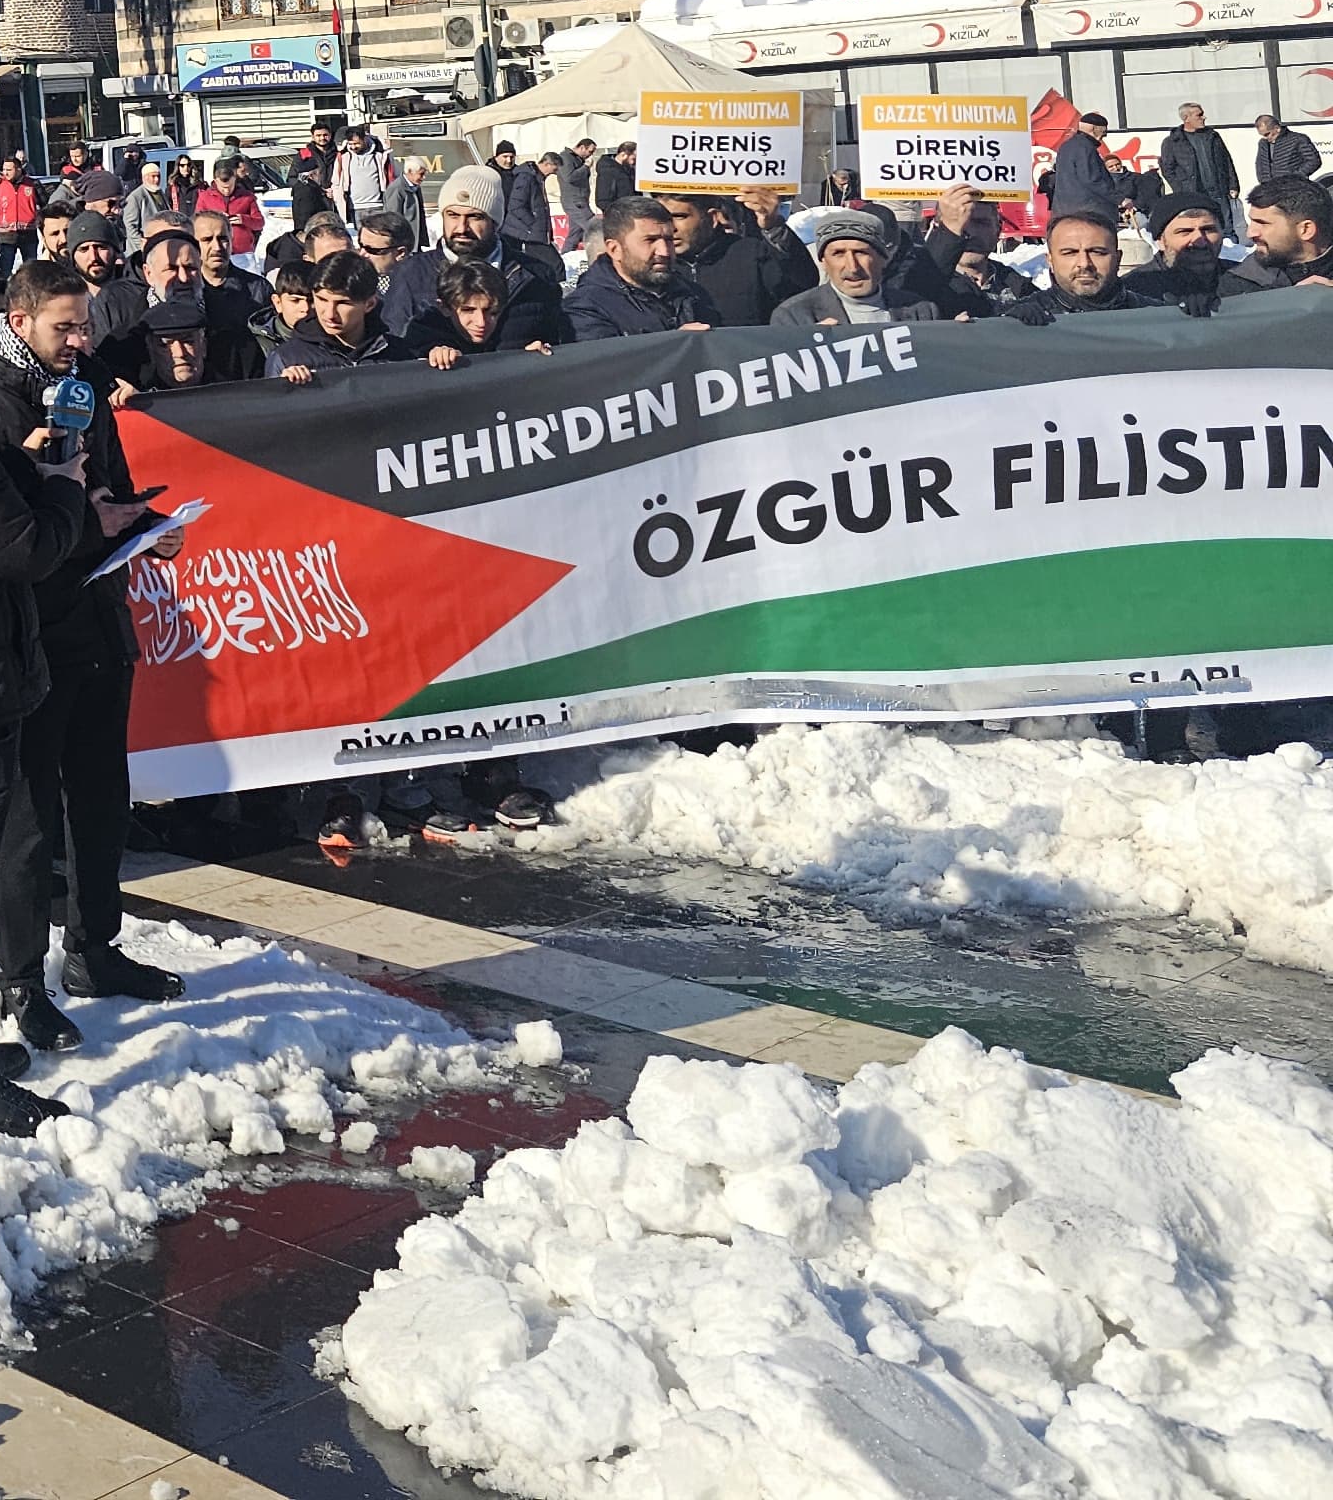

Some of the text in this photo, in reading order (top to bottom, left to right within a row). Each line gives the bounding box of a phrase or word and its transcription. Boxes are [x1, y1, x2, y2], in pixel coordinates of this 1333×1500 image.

[1095, 16, 1141, 29] KIZILAY
[1208, 7, 1255, 21] KIZILAY
[852, 37, 891, 50] KIZILAY
[949, 28, 990, 41] KIZILAY
[760, 46, 797, 58] KIZILAY
[243, 69, 318, 86] MÜDÜRLÜĞÜ
[652, 99, 790, 120] GAZZE'Yİ UNUTMA
[873, 102, 1017, 125] GAZZE'Yİ UNUTMA
[671, 130, 772, 157] DİRENİŞ
[896, 135, 1001, 161] DİRENİŞ
[654, 154, 786, 176] SÜRÜYOR!
[880, 159, 1016, 182] SÜRÜYOR!
[376, 325, 918, 493] NEHİR'DEN DENİZ'E
[633, 446, 960, 579] ÖZGÜR
